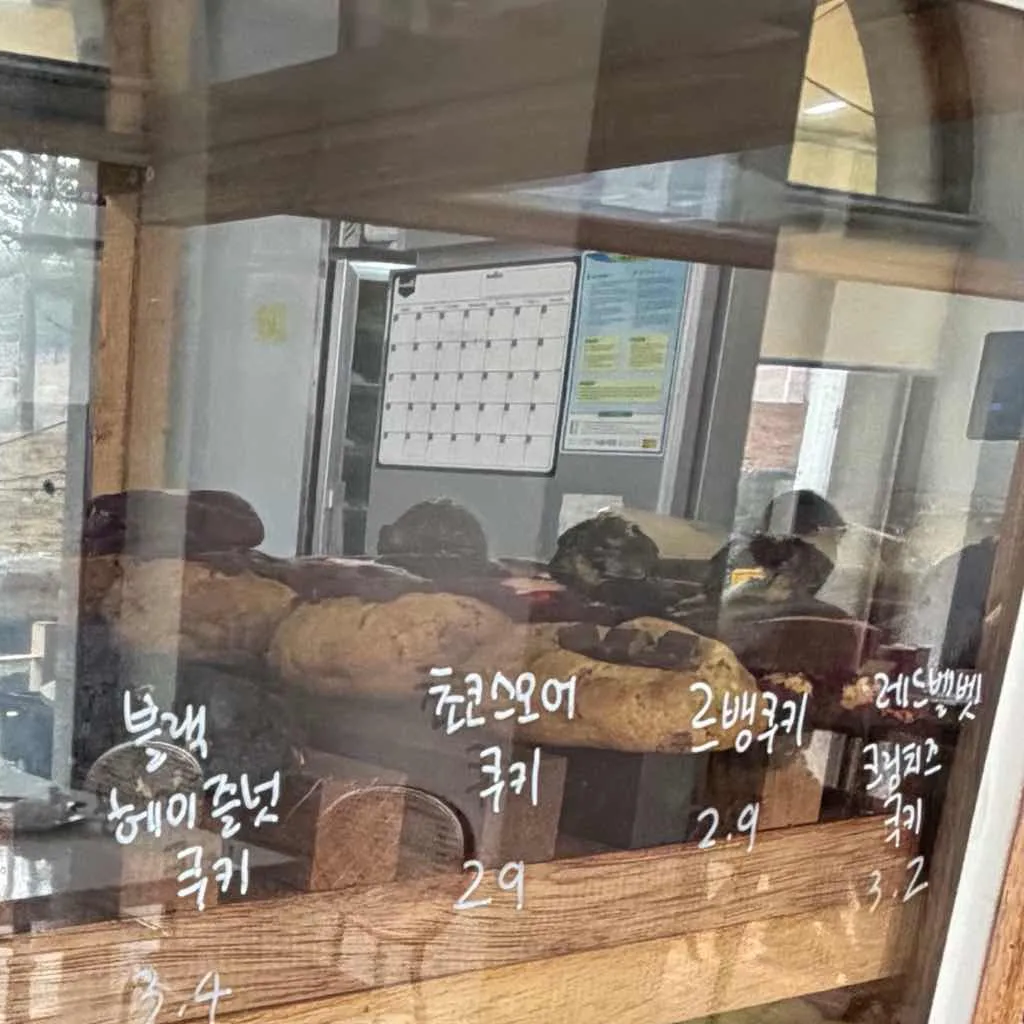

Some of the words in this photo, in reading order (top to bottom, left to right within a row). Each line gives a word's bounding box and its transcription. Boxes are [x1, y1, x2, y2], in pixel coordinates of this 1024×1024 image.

[874, 667, 982, 721] 레드벨벳
[123, 689, 209, 773] 블랙
[107, 769, 282, 845] 헤이즐넛
[479, 745, 541, 813] 쿠키
[696, 802, 760, 853] 2.9
[883, 793, 923, 848] 쿠키
[176, 844, 250, 912] 쿠키
[864, 855, 929, 913] 3.2
